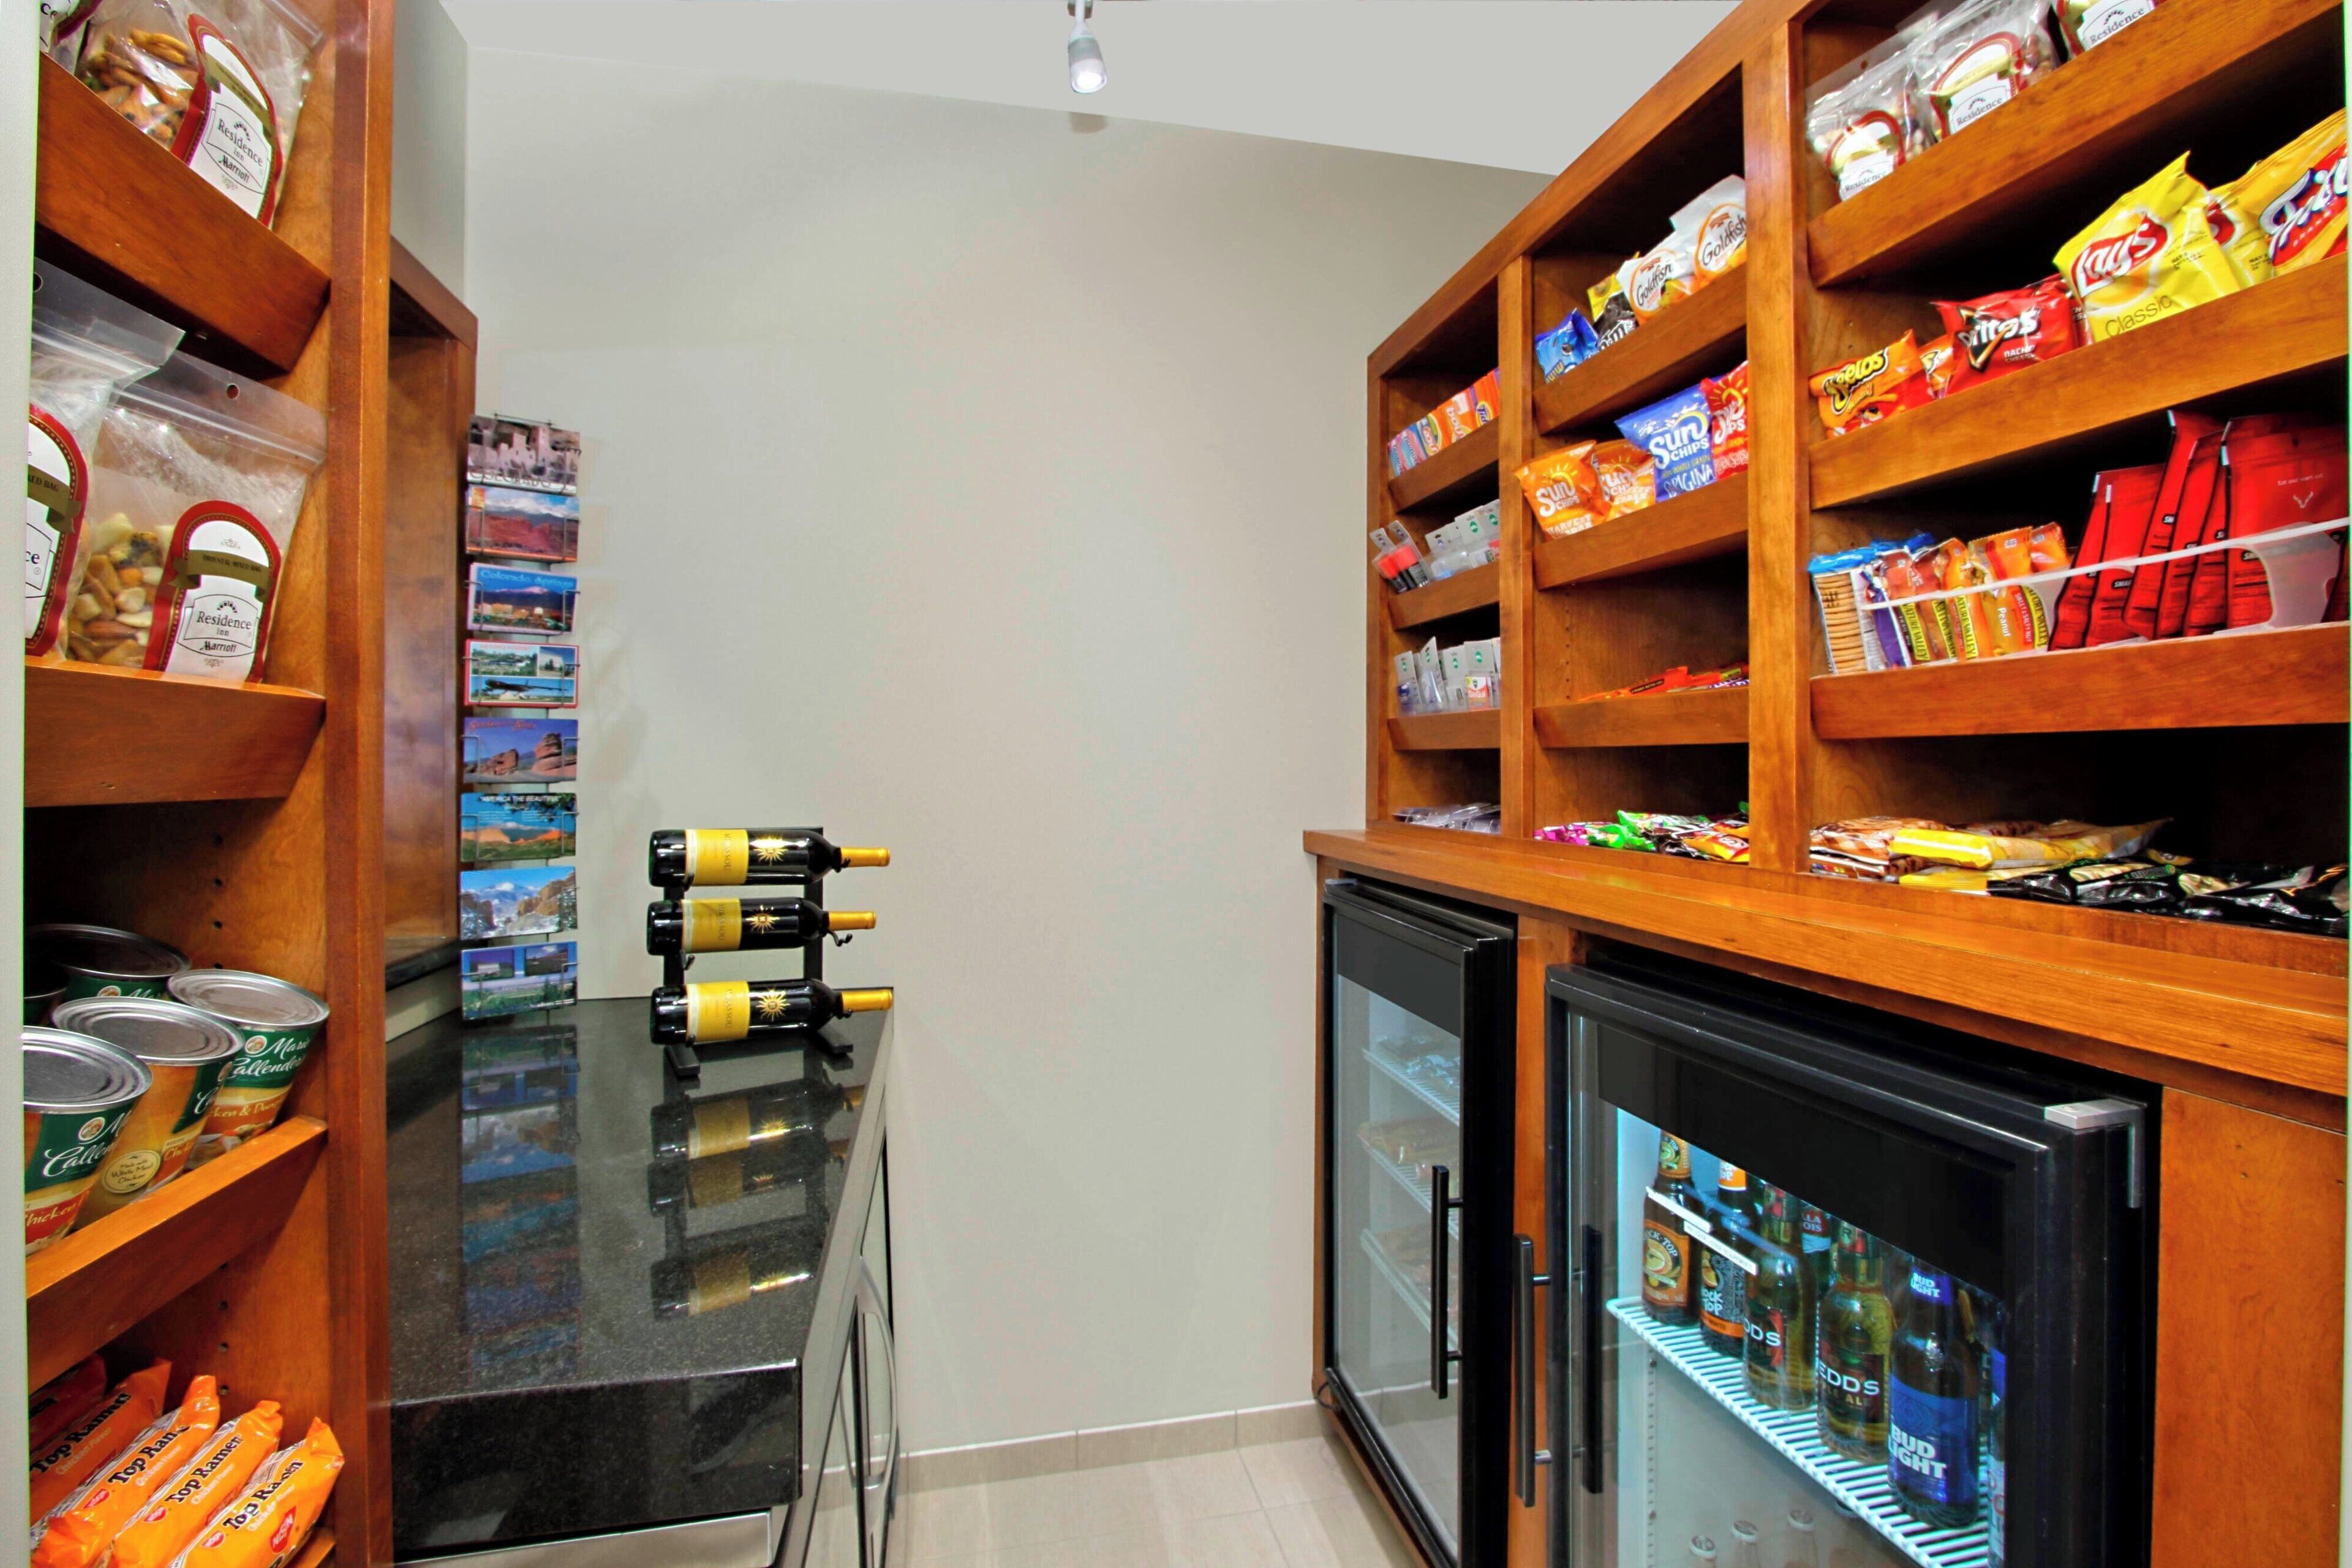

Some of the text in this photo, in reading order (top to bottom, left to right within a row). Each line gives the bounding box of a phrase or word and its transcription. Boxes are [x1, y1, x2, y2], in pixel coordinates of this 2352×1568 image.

[2089, 8, 2144, 43] Residence
[1957, 97, 2002, 126] Residence
[217, 118, 263, 167] Residence
[233, 146, 244, 162] Inn
[219, 154, 250, 183] Marriott
[2105, 292, 2172, 337] Classic
[1477, 405, 1488, 424] Tid
[1649, 413, 1709, 470] Sun
[1670, 438, 1709, 461] CHIPS
[1536, 481, 1576, 517] Sun
[1555, 495, 1580, 510] CHIPS
[480, 570, 530, 582] Colorado
[196, 611, 252, 630] Residence
[1956, 595, 1970, 620] ATURE
[1998, 607, 2011, 637] Peanut
[199, 640, 237, 653] Marriott
[216, 628, 230, 636] Inn
[25, 1201, 77, 1227] hicken
[1913, 1272, 1936, 1287] BUD
[1819, 1359, 1880, 1395] EDDS
[30, 1443, 72, 1472] Top
[64, 1393, 132, 1443] Ramen
[1891, 1422, 1936, 1460] BUD
[107, 1457, 146, 1484] Top
[164, 1434, 244, 1503] Top Ramen
[1888, 1433, 1947, 1479] LIGHT
[222, 1501, 260, 1530] Top
